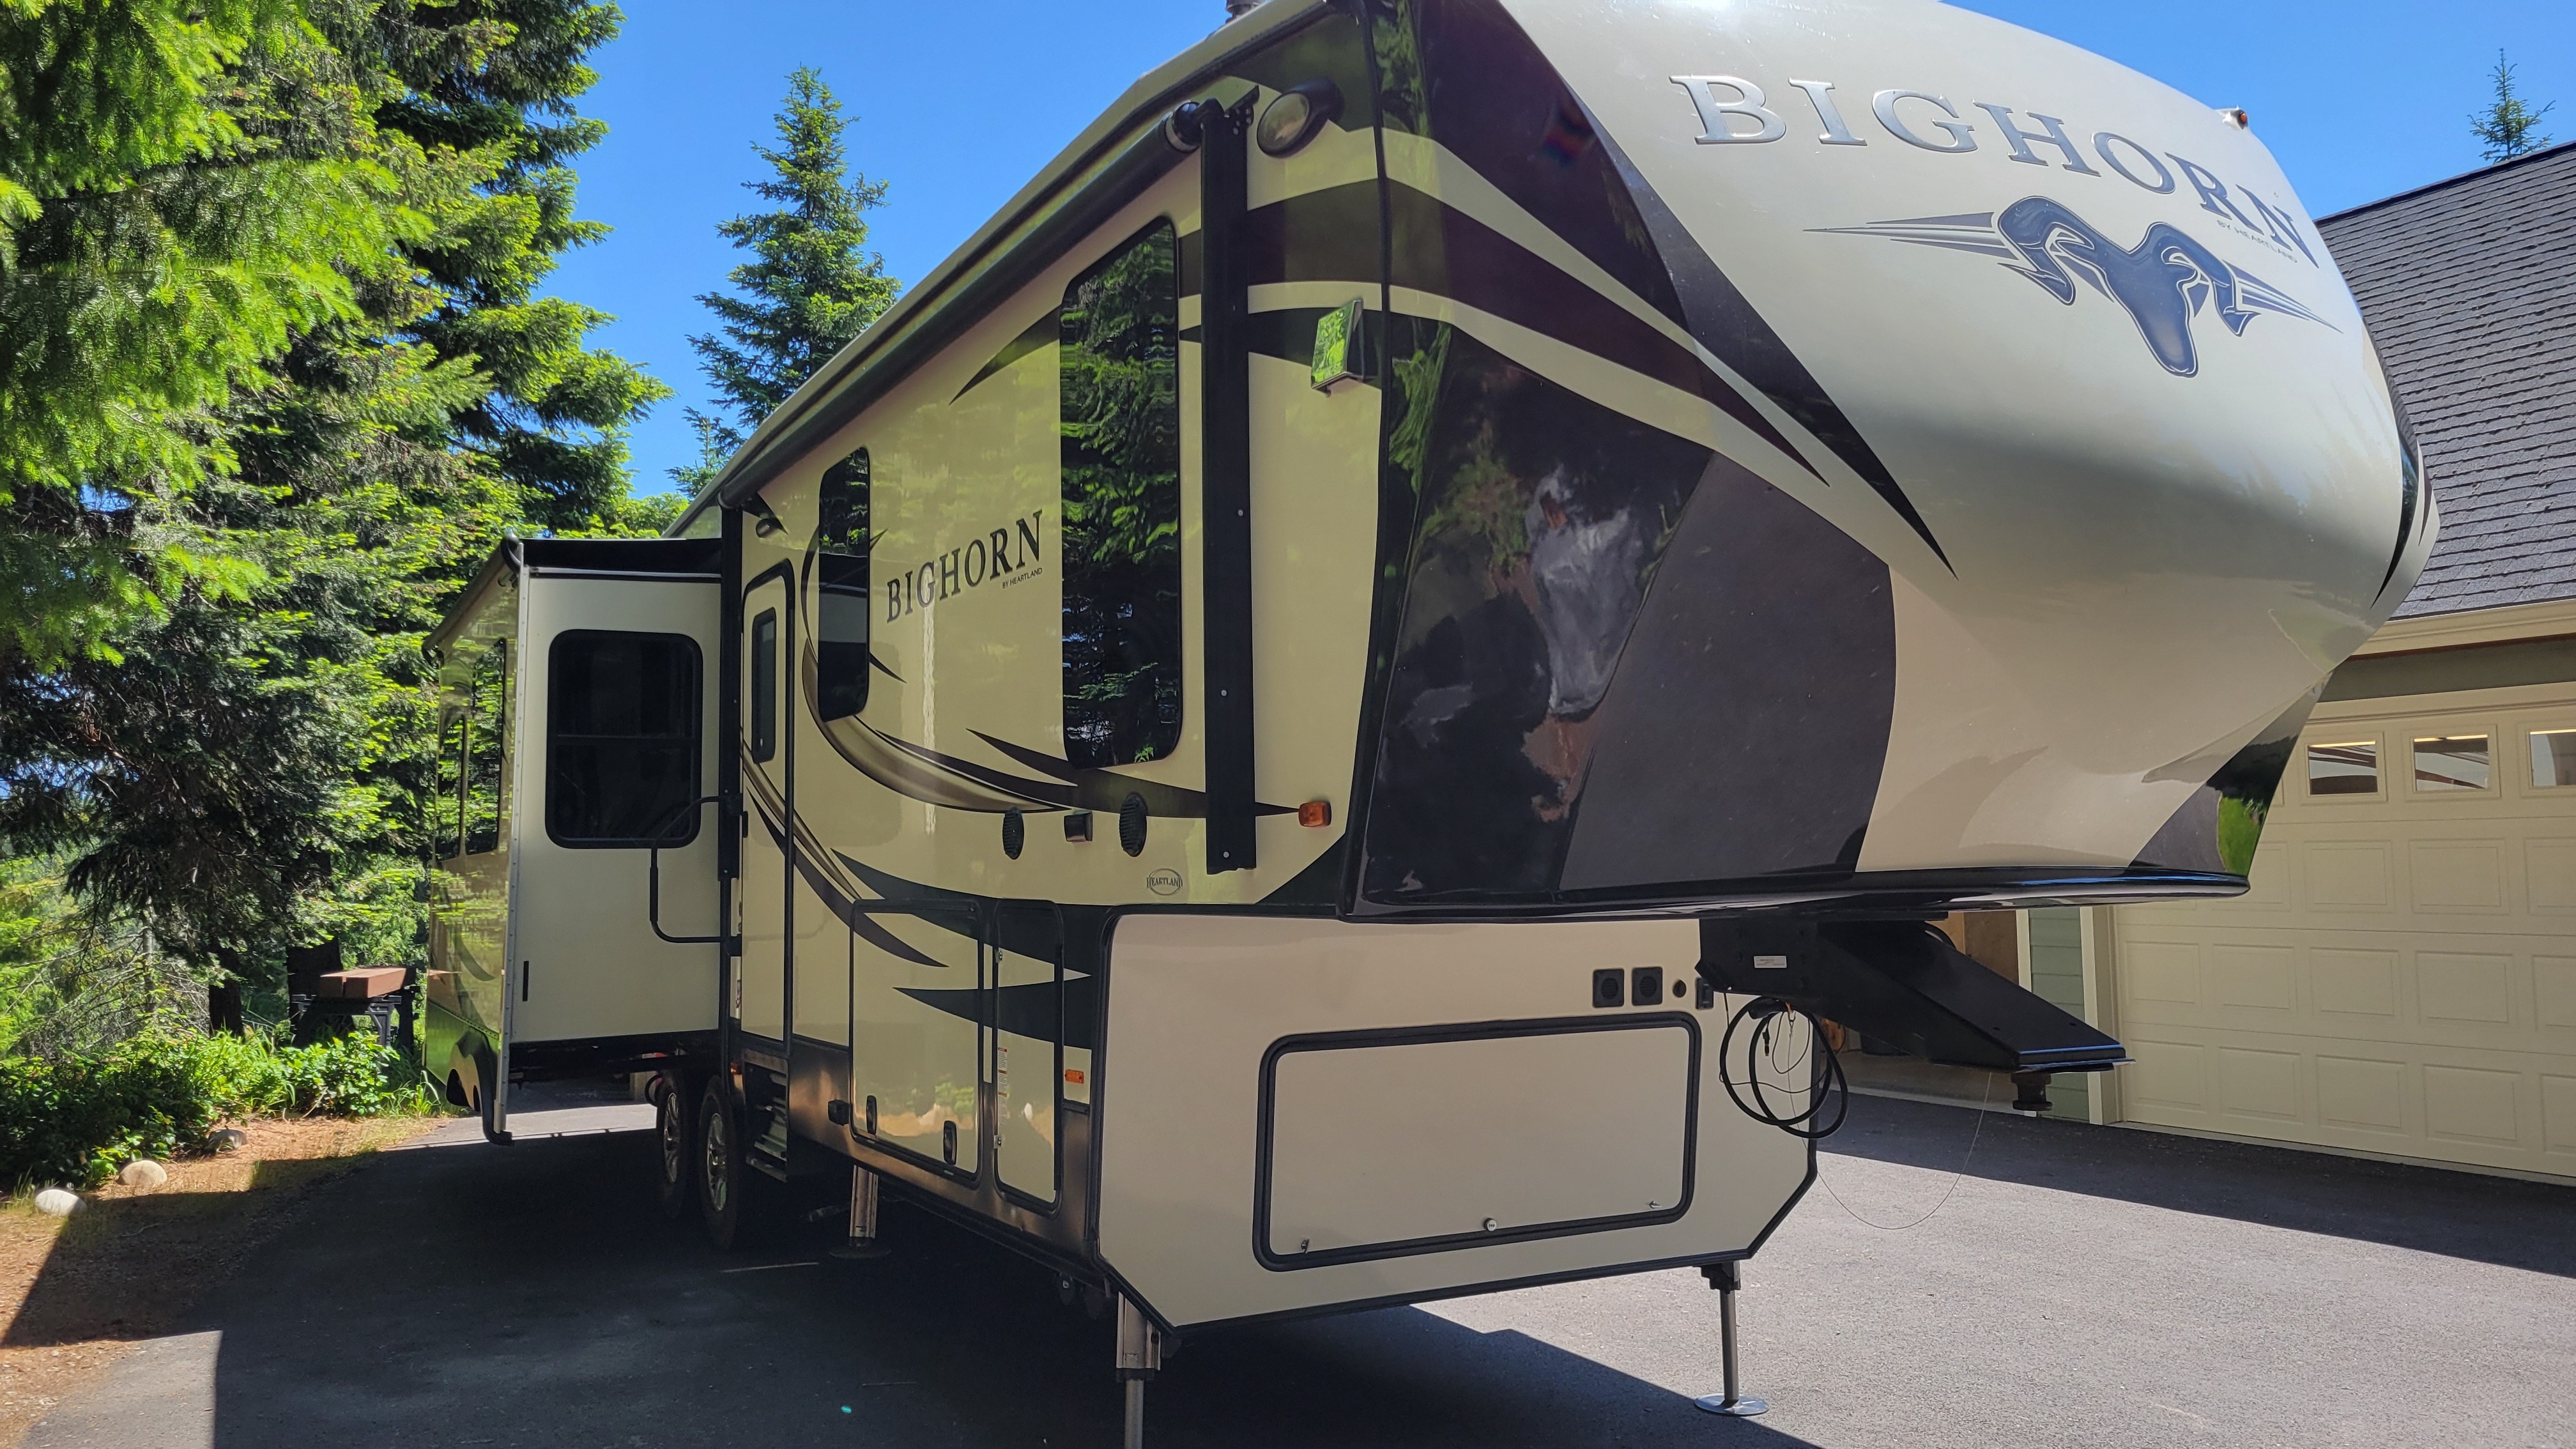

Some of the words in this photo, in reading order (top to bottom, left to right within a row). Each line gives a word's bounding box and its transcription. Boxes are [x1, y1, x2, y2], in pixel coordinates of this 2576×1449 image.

[1668, 73, 2320, 269] BIGHORN
[2216, 220, 2232, 231] BY
[886, 508, 1043, 624] BIGHORN
[1010, 567, 1043, 586] HEARTLAND
[1146, 877, 1183, 889] HEARTLAND
